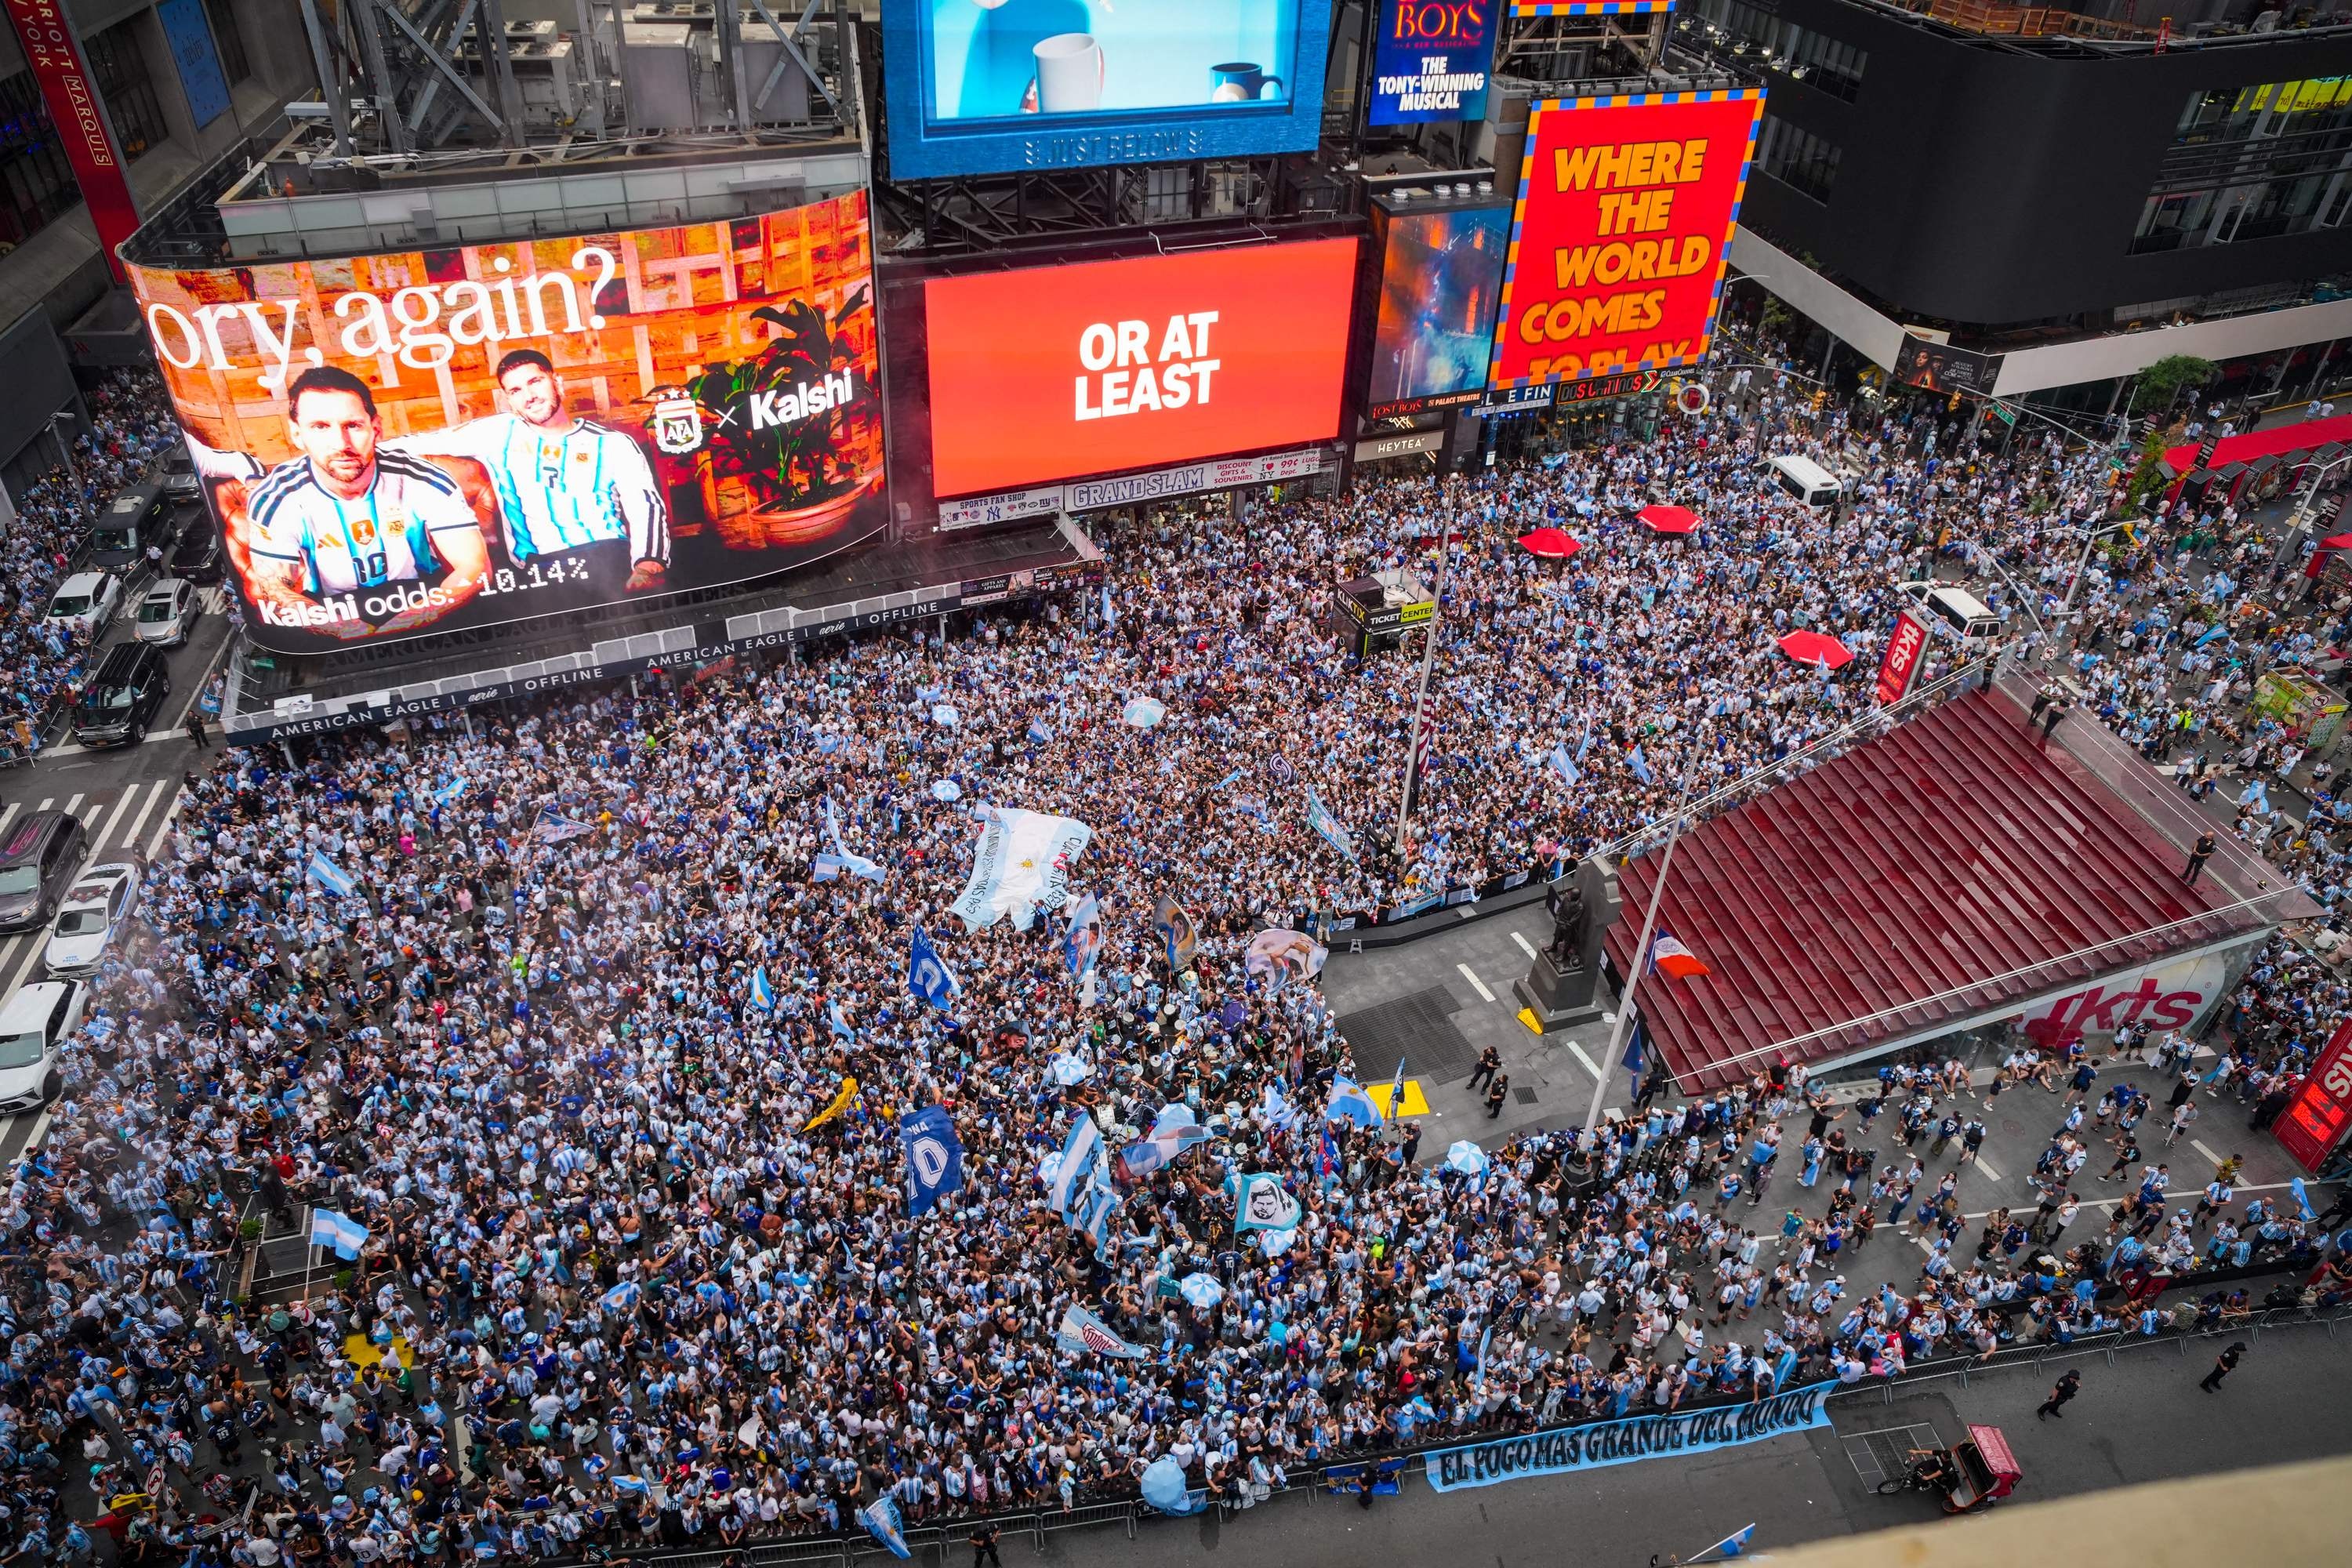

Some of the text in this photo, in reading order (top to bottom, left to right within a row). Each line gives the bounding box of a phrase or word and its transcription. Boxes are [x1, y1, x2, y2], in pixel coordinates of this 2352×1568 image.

[1393, 0, 1484, 39] BOYS
[21, 15, 53, 67] YORK
[1421, 56, 1448, 74] THE
[1378, 72, 1484, 95] TONY-WINNING
[1399, 90, 1460, 111] MUSICAL
[66, 78, 110, 163] MARQUIS
[1047, 129, 1182, 164] JUST BELOW
[1553, 138, 1710, 194] WHERE
[1597, 188, 1675, 238] THE
[1554, 235, 1712, 291] WORLD
[141, 247, 615, 389] ory, again?
[1519, 289, 1668, 345] COMES
[1080, 311, 1219, 371] OR AT
[749, 365, 854, 430] Kalshi
[1076, 360, 1221, 421] LEAST
[1435, 393, 1480, 406] PALACE THEATRE
[1523, 384, 1552, 401] FIN
[1561, 381, 1585, 401] DOS
[1373, 399, 1422, 419] LOST BOYS
[1377, 439, 1421, 453] HEYTEA
[543, 466, 559, 488] 7
[1214, 474, 1253, 484] SOUVENIRS
[1217, 461, 1253, 470] DISCOUNT
[1259, 470, 1275, 481] NY
[960, 492, 1026, 510] SPORTS FAN SHOP
[1073, 467, 1204, 508] GRAND SLAM
[352, 551, 389, 583] 10
[257, 556, 590, 628] Kalshi odds: 10.14%
[1370, 613, 1401, 625] TICKET
[647, 630, 796, 668] AMERICAN EAGLE
[1891, 622, 1920, 673] tkts
[271, 697, 441, 739] AMERICAN EAGLE
[1225, 1260, 1235, 1269] 10
[1271, 1281, 1282, 1291] 10
[2058, 1320, 2070, 1333] 10
[1893, 1338, 1902, 1348] 10
[1439, 1388, 1820, 1486] EL POGO MAS GRANDE DEL MUNDO
[356, 1550, 371, 1559] 10
